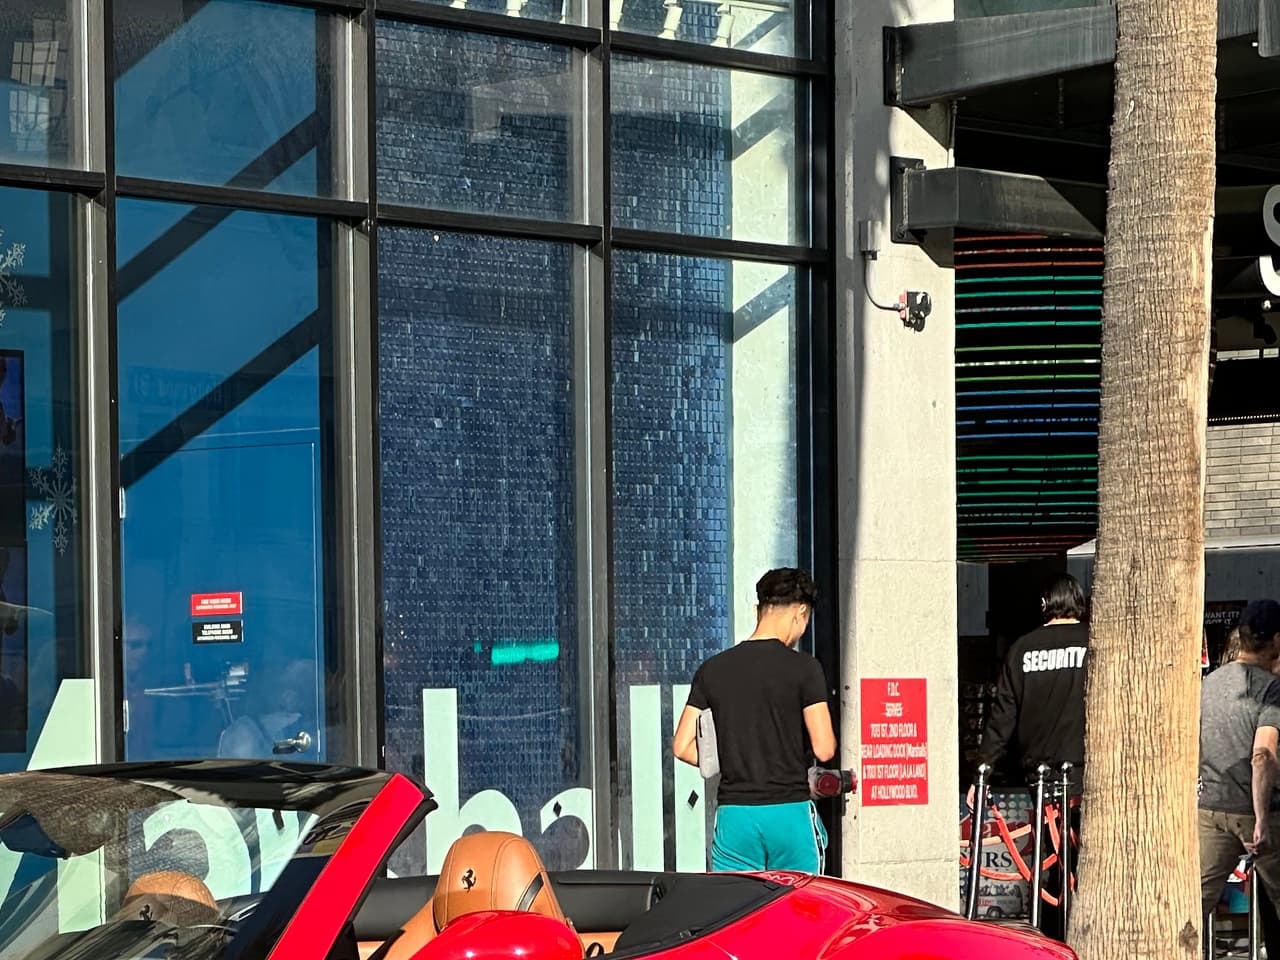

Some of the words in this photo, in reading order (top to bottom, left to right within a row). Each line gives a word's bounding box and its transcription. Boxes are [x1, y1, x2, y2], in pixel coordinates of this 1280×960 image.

[1023, 646, 1087, 673] SECURITY
[899, 723, 913, 738] FLOOR
[873, 744, 893, 758] LOADING
[894, 744, 906, 758] DOCK
[878, 784, 905, 799] HOLLYWOOD
